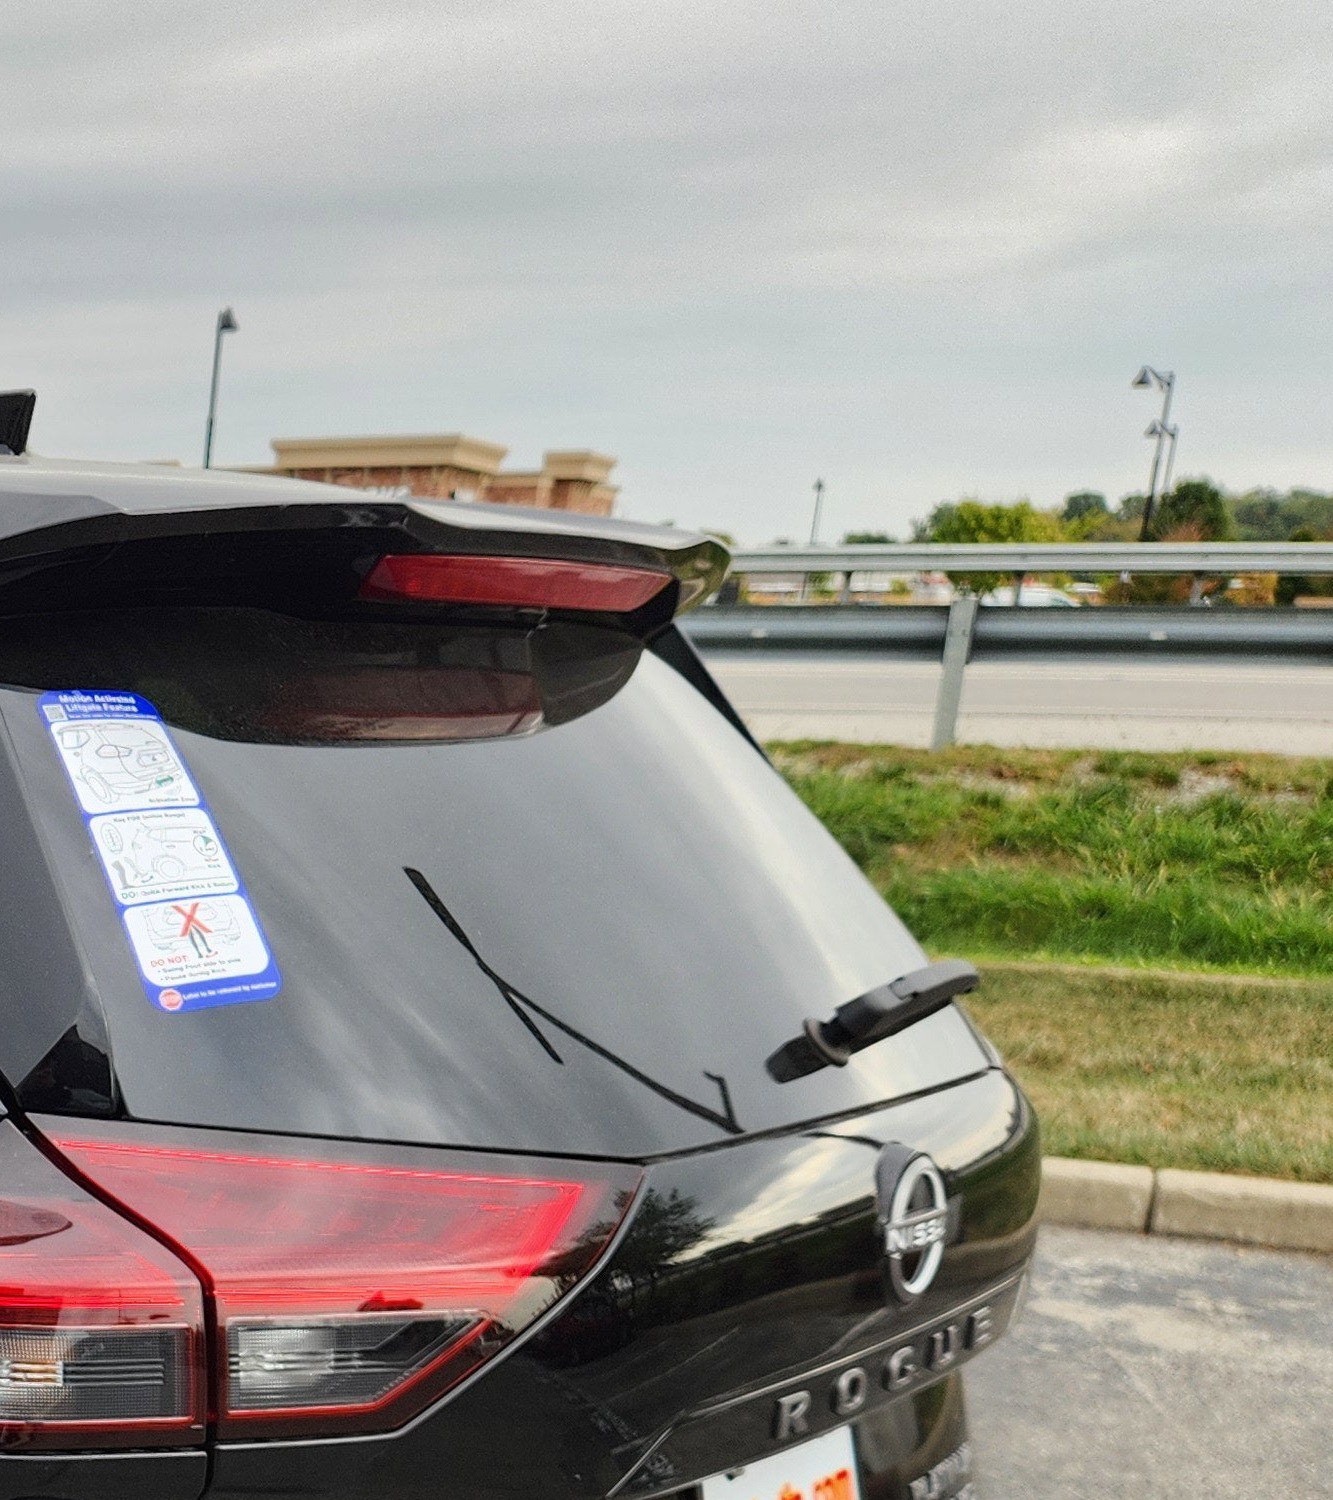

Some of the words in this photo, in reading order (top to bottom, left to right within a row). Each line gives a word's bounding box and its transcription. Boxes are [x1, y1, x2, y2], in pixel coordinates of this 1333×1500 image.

[58, 694, 93, 703] Motion
[94, 694, 136, 704] Activated
[102, 703, 139, 712] Feature
[773, 1305, 992, 1440] ROGUE
